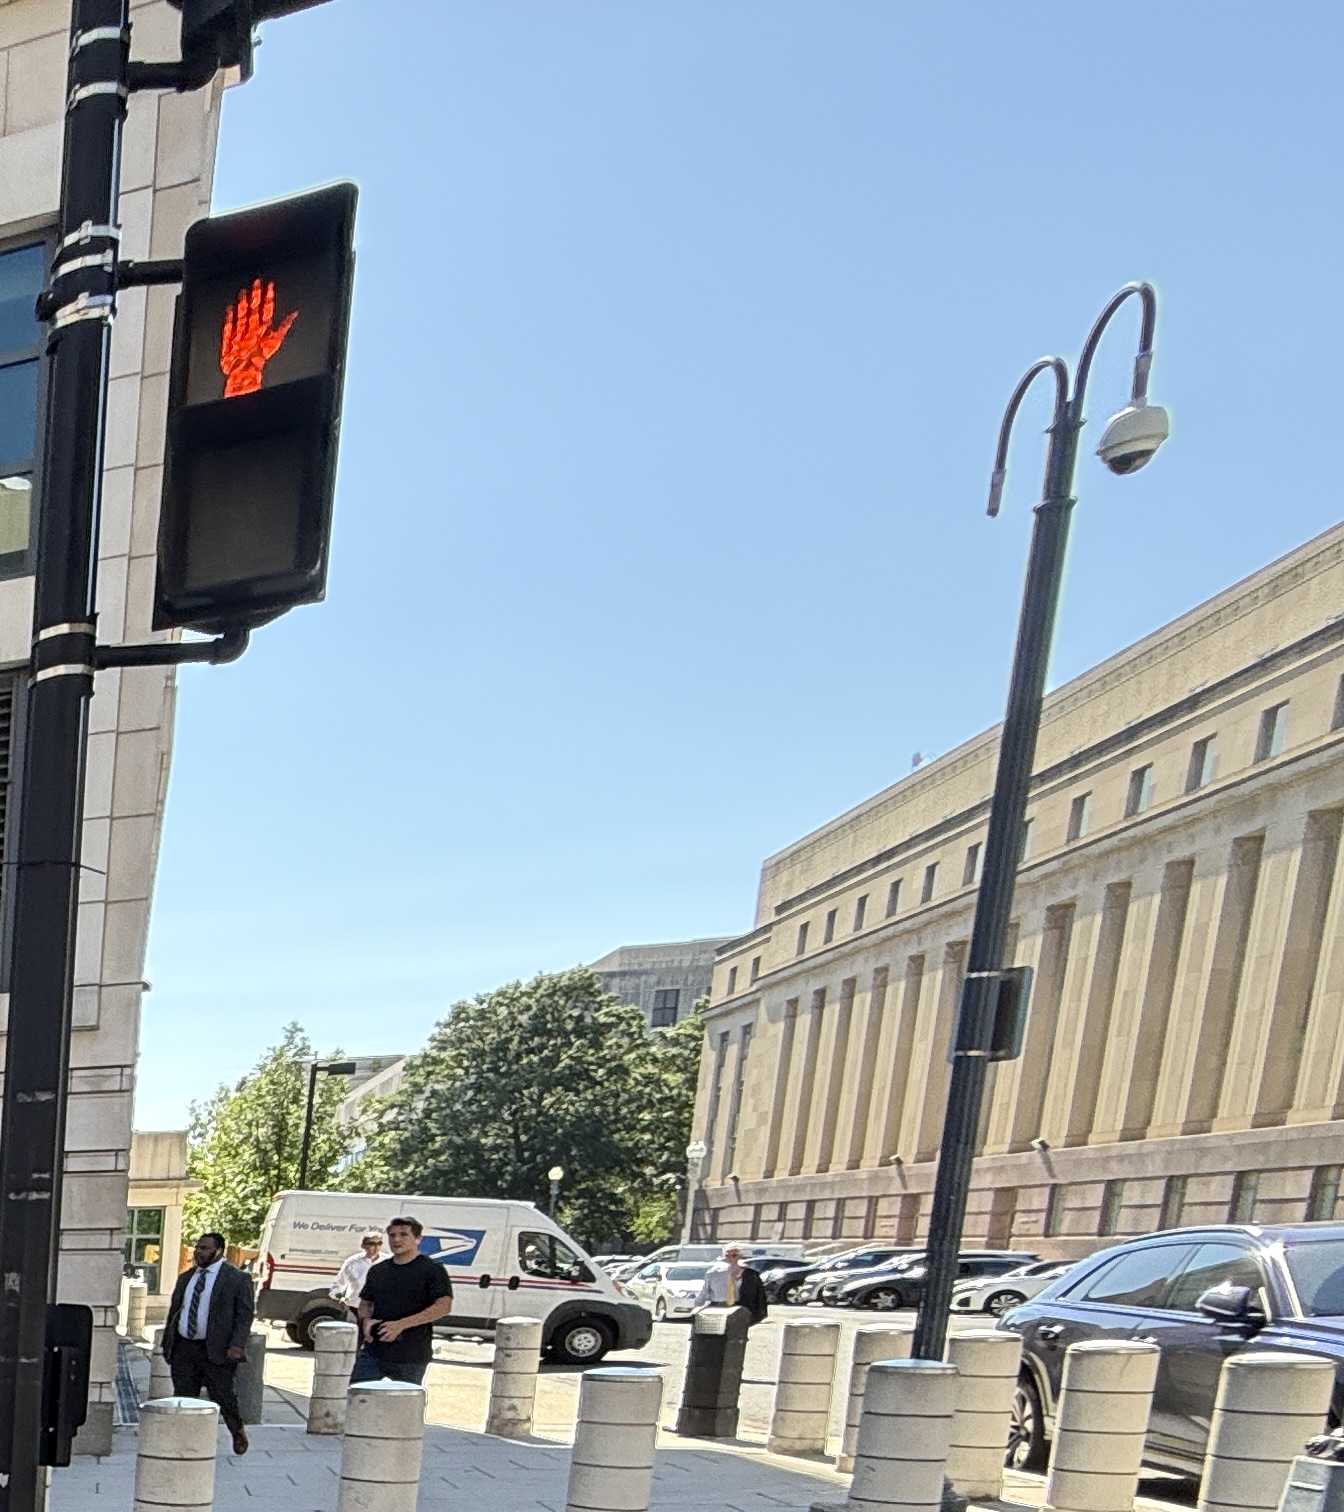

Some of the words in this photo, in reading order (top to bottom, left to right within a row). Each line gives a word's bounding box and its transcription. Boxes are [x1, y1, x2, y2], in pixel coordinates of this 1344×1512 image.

[293, 1221, 309, 1230] We
[311, 1222, 347, 1232] Deliver
[348, 1224, 367, 1233] For
